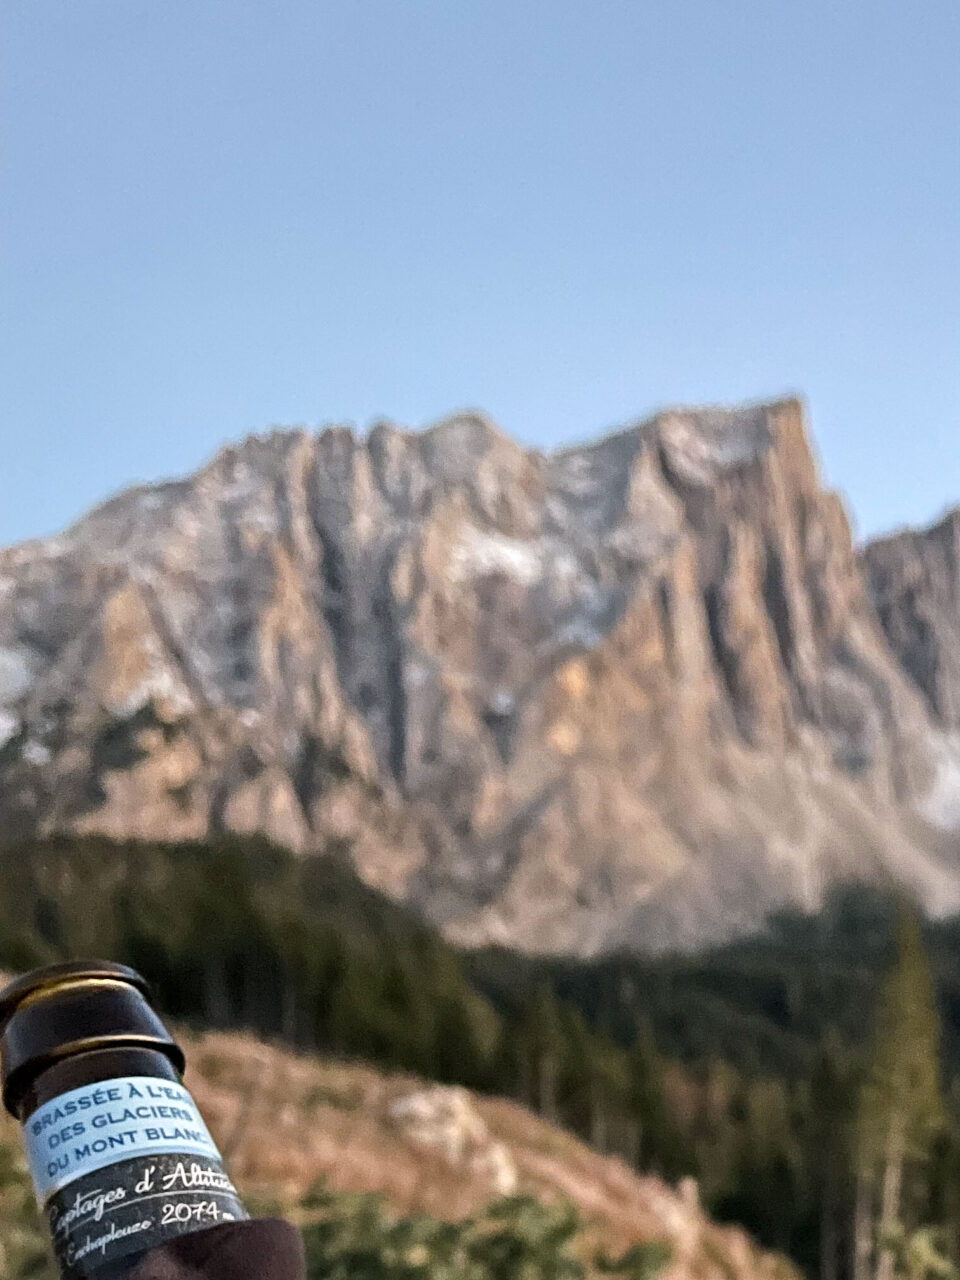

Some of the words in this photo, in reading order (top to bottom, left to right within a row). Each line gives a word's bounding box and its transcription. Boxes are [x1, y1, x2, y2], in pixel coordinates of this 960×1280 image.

[31, 1087, 122, 1137] BRASSÉE
[128, 1082, 143, 1099] À
[48, 1122, 86, 1150] DES
[91, 1105, 193, 1129] GLACIERS
[47, 1153, 69, 1178] DU
[74, 1131, 138, 1161] MONT
[145, 1128, 209, 1144] BLANC
[161, 1200, 221, 1225] 2074
